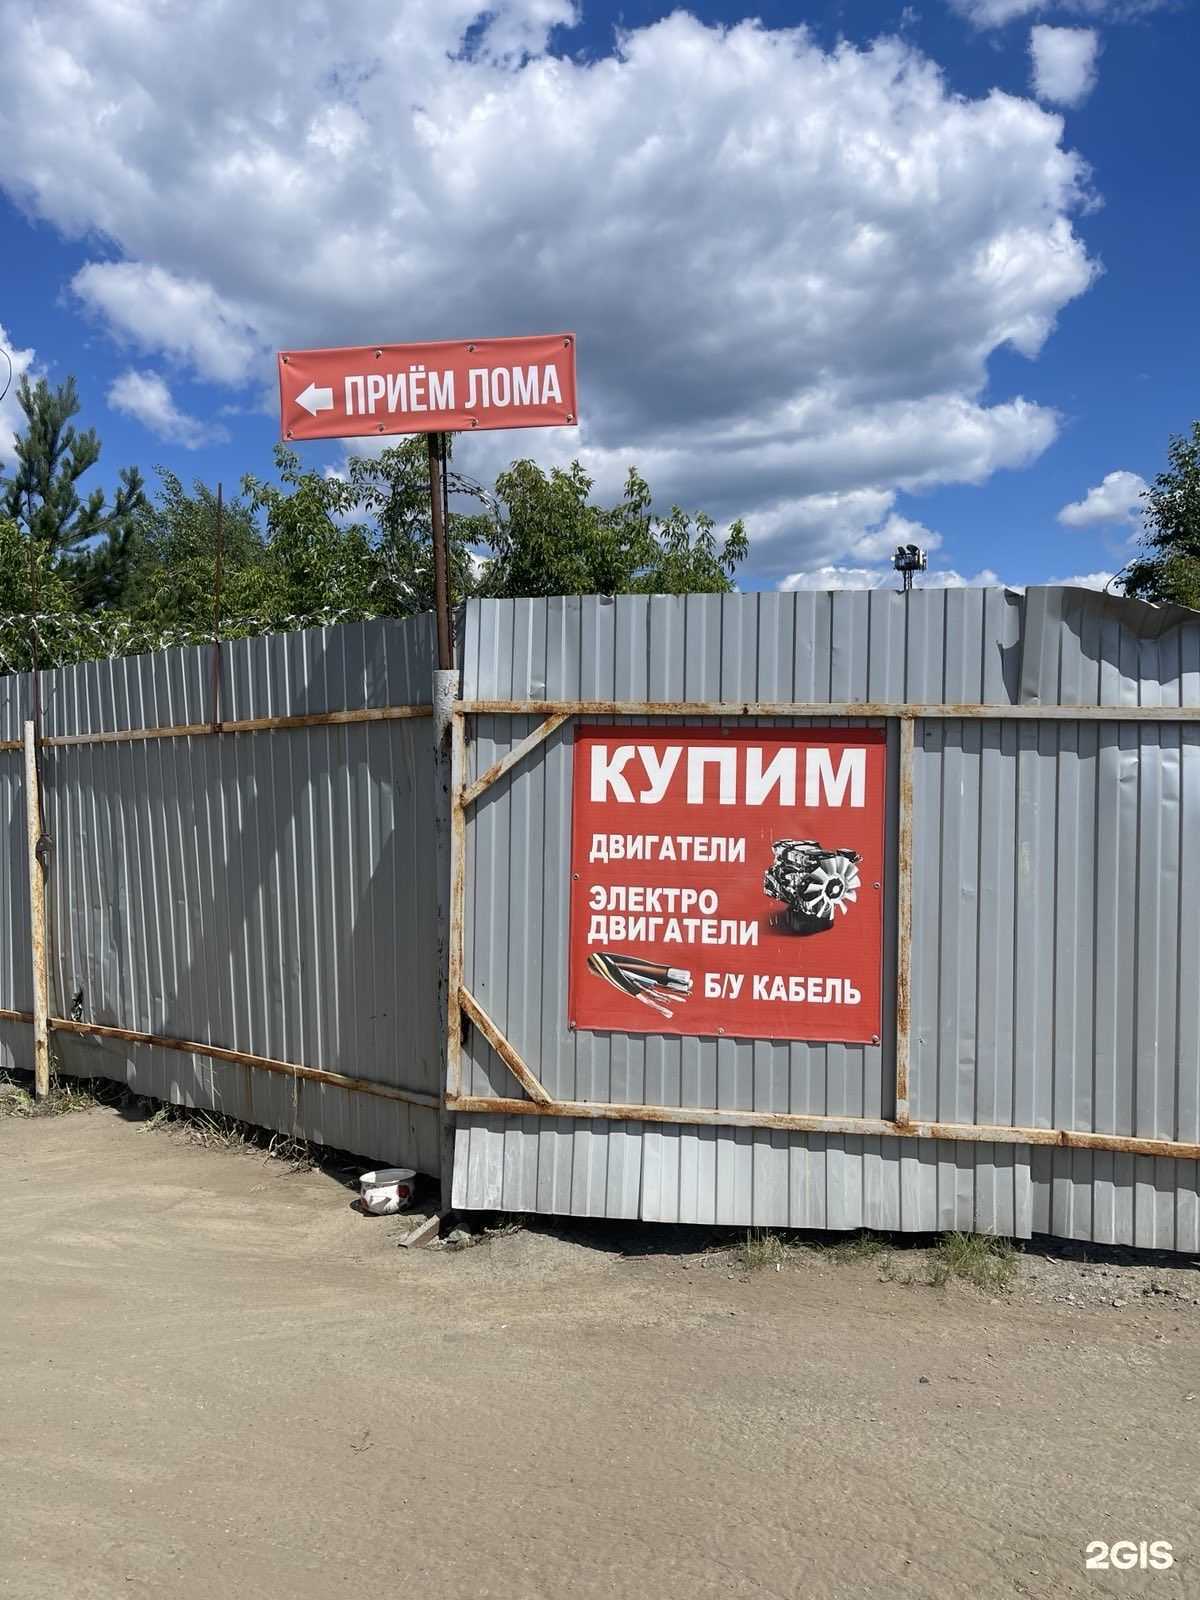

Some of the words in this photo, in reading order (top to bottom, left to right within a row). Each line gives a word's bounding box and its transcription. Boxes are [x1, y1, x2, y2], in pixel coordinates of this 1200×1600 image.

[344, 365, 456, 415] ПРИЁМ
[464, 364, 563, 409] ЛОМА
[590, 745, 867, 807] КУПИМ
[589, 834, 746, 864] ДВИГАТЕЛИ
[588, 885, 719, 915] ЭЛЕКТРО
[587, 915, 759, 946] ДВИГАТЕЛИ
[704, 973, 745, 999] Б/У
[752, 975, 862, 1005] КАБЕЛЬ
